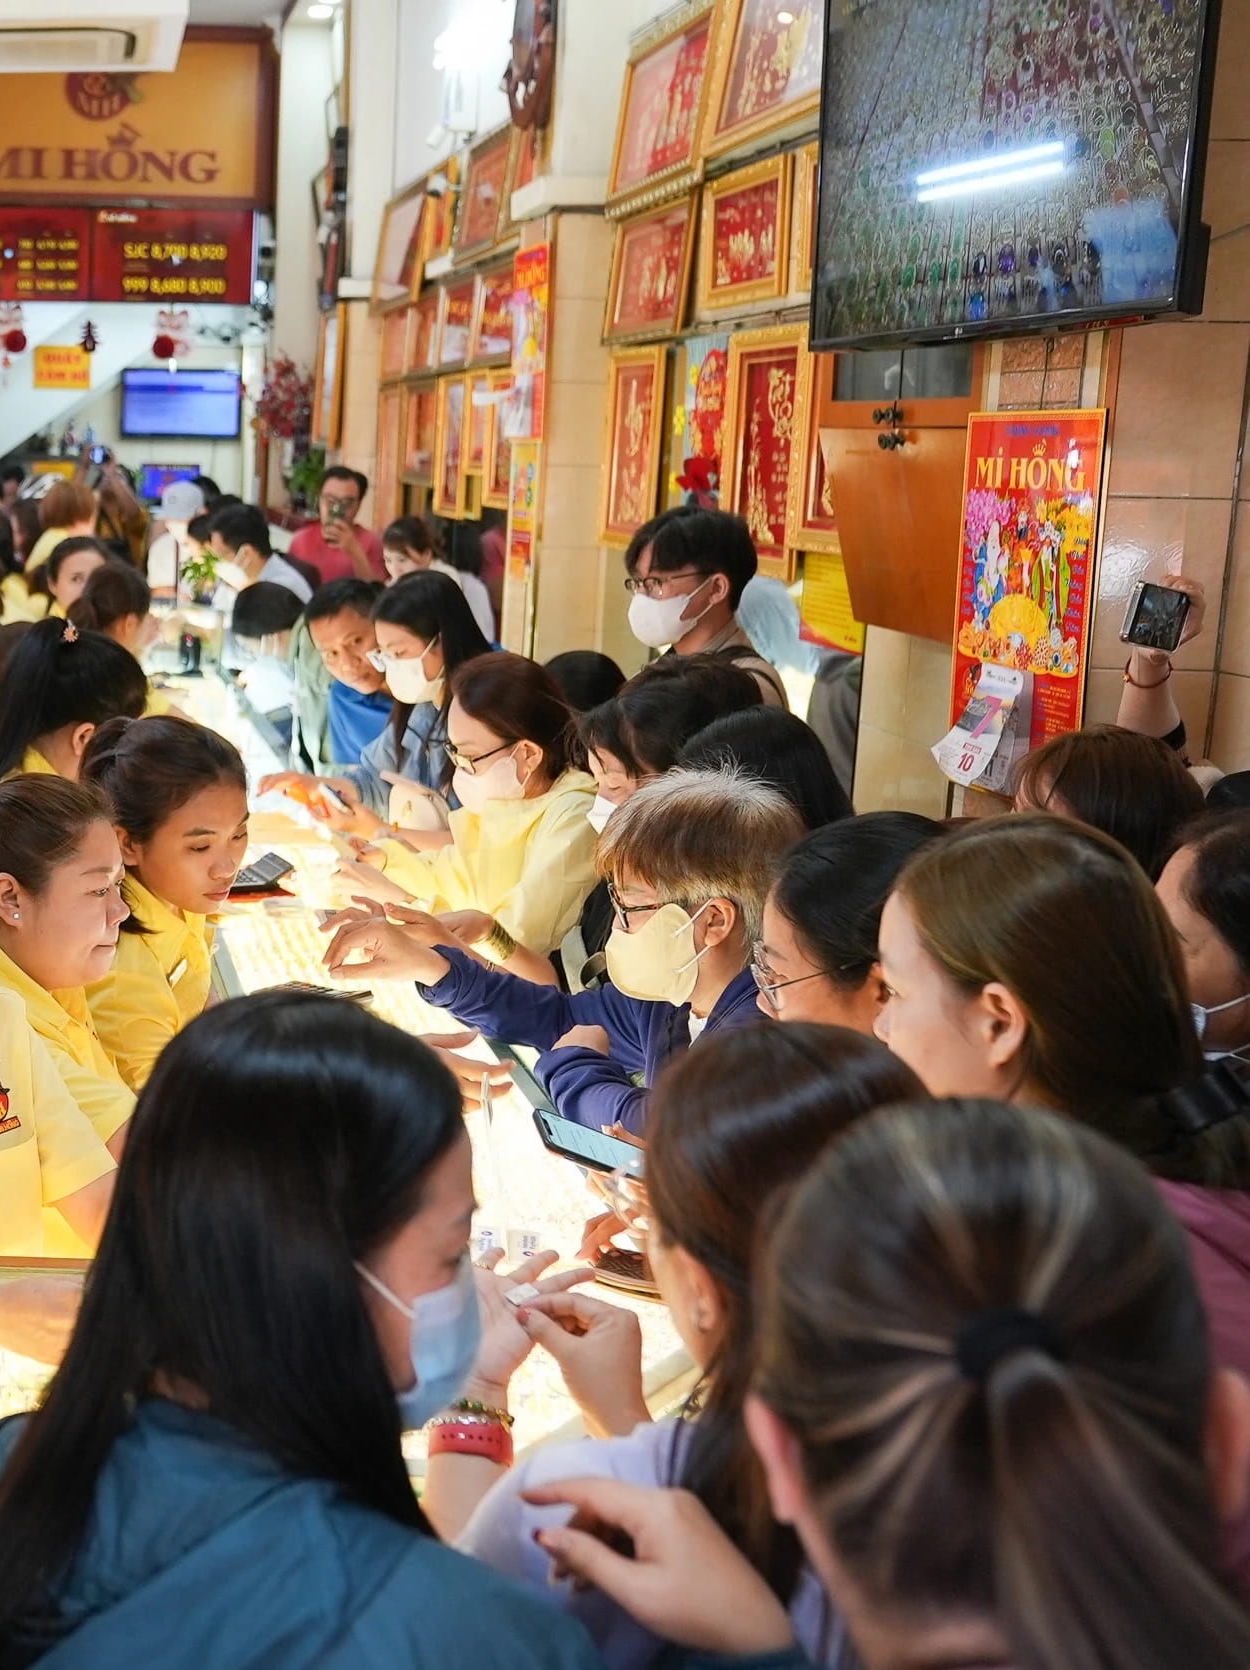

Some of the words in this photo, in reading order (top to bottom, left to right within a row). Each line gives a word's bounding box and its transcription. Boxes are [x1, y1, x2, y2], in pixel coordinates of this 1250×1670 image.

[123, 242, 150, 259] SJC
[122, 276, 149, 293] 999
[957, 752, 975, 772] 10
